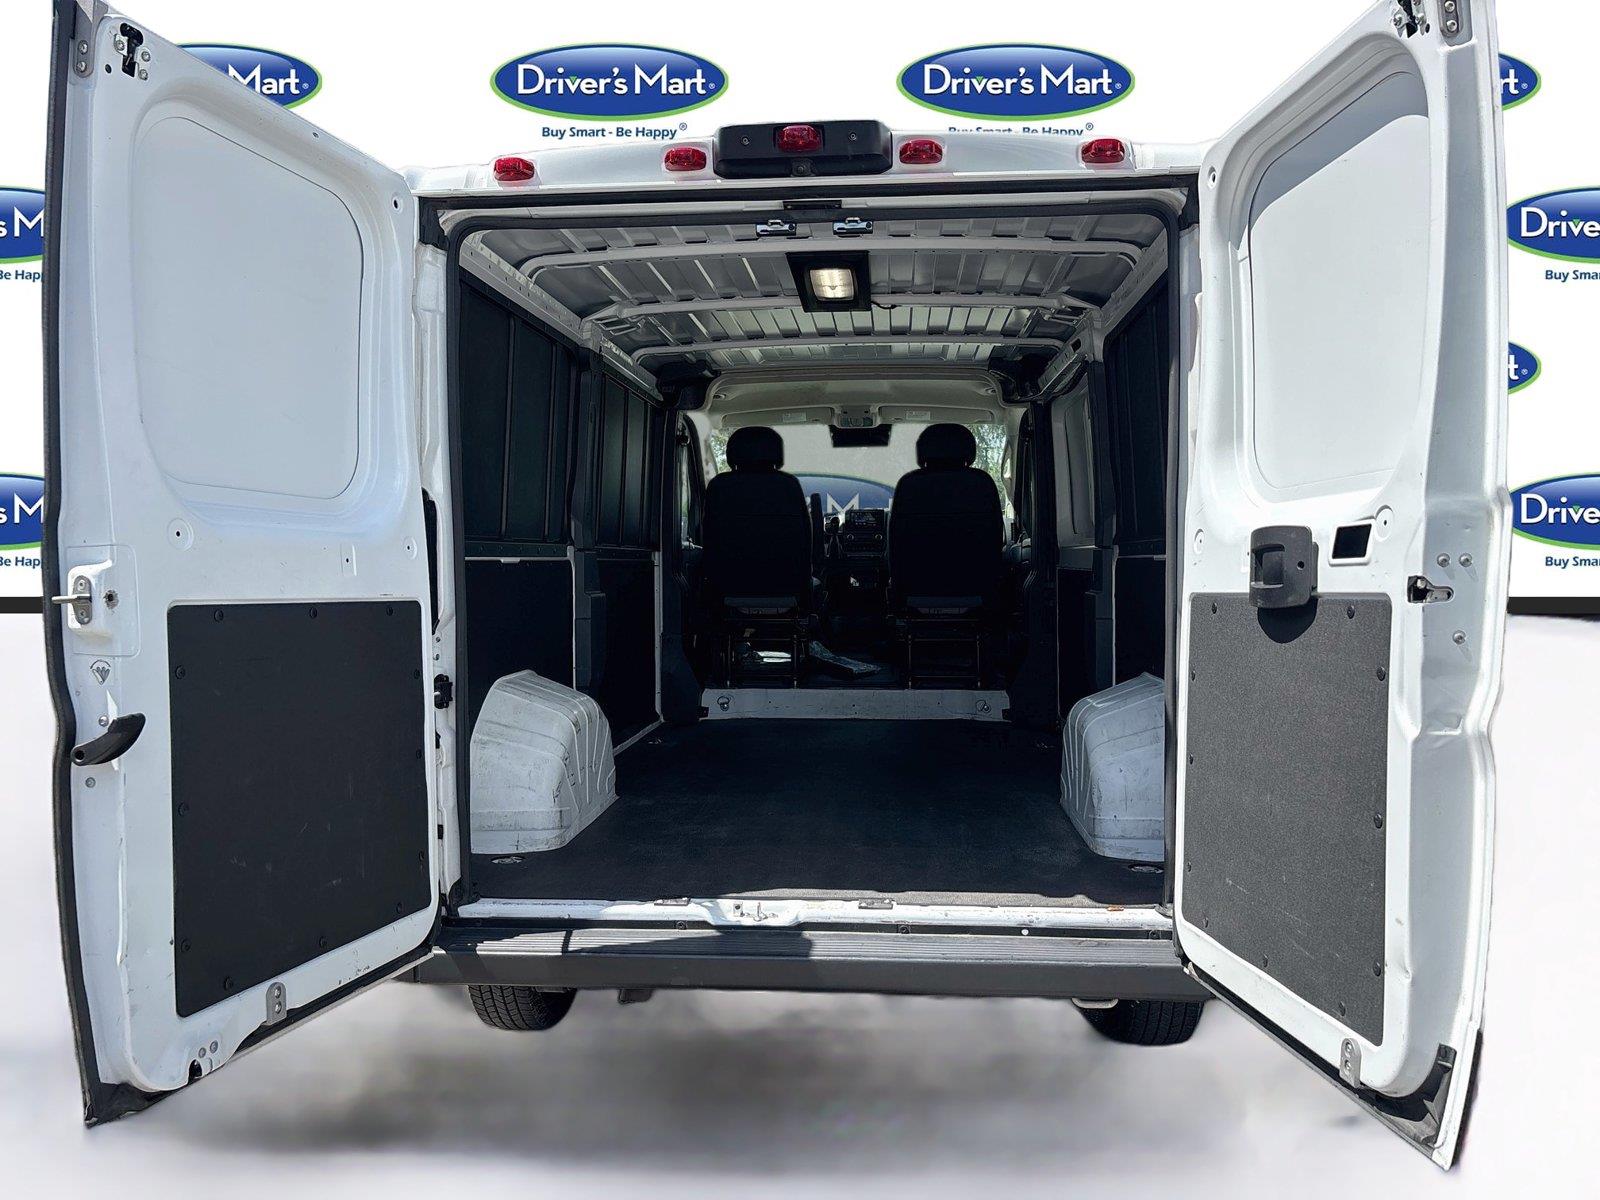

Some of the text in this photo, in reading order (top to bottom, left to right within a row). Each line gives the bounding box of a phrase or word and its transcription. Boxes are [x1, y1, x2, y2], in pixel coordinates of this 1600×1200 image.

[517, 64, 628, 94] Driver's
[923, 64, 1035, 94] Driver's
[542, 127, 566, 139] Buy
[569, 127, 606, 137] Smart
[616, 127, 632, 137] Be
[635, 127, 677, 139] Happy
[1545, 270, 1569, 282] Buy
[1545, 556, 1569, 569] Buy
